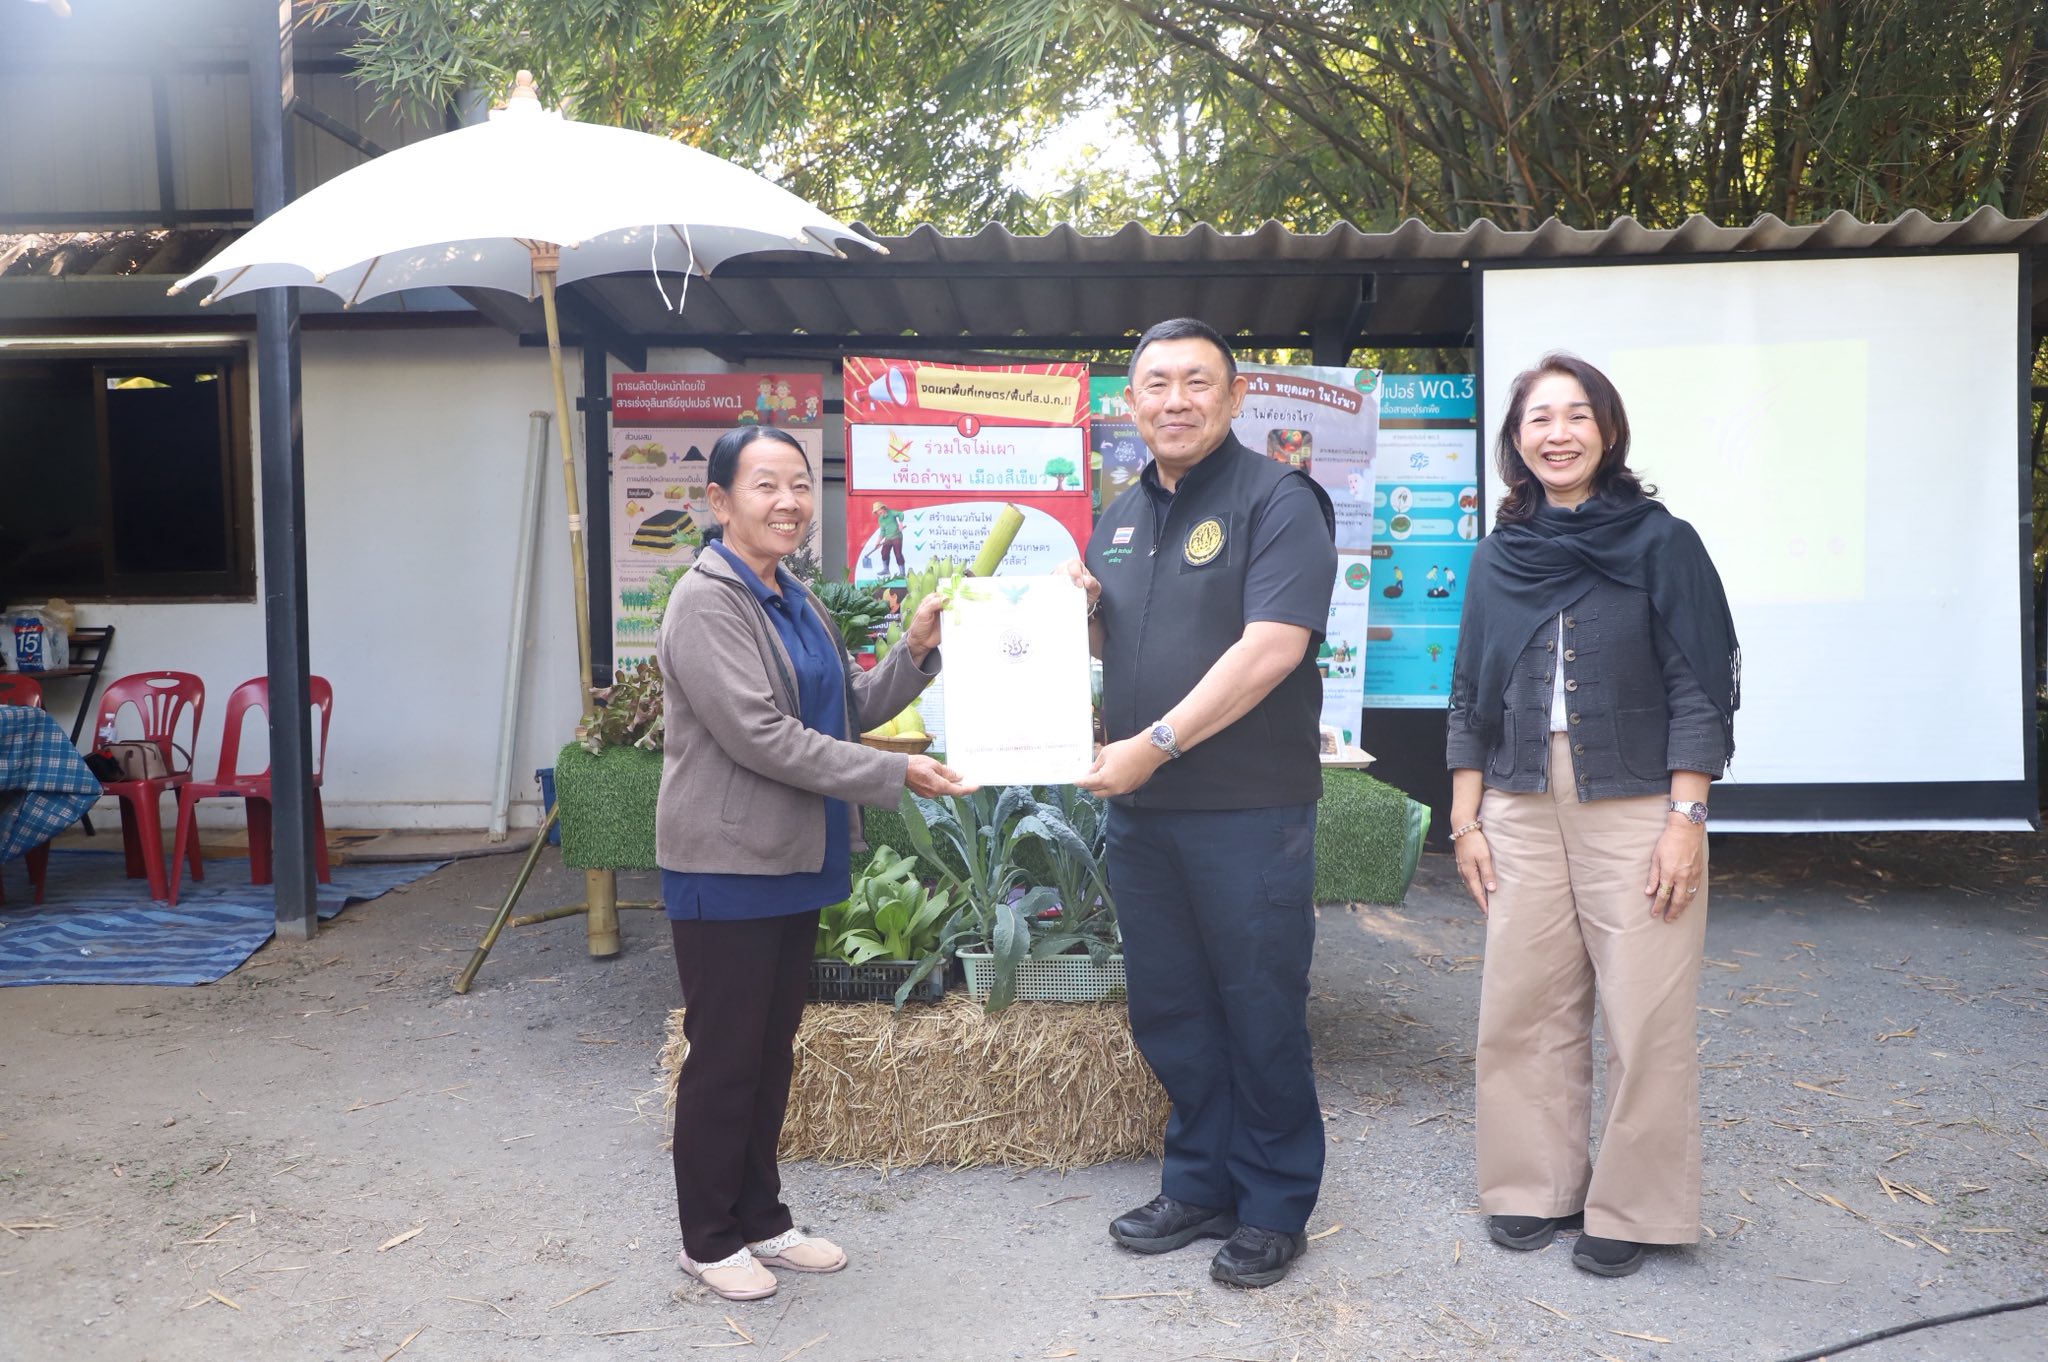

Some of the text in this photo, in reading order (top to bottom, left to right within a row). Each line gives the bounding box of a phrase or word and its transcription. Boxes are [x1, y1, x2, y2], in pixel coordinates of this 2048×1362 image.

[617, 379, 706, 394] การผลิตปุ๋ยหมักโดยใช้
[1248, 377, 1357, 410] มใจ หยุดเผา ในไร่นา
[1380, 378, 1474, 399] ปเปอร์ พด.3
[713, 395, 742, 408] พด.1
[924, 438, 1015, 455] ร่วมใจไม่เผา
[893, 464, 1048, 489] เพื่อลำพูน เมืองสีเขียว
[929, 512, 992, 522] สร้างแนวกันไฟ
[18, 633, 39, 653] 15
